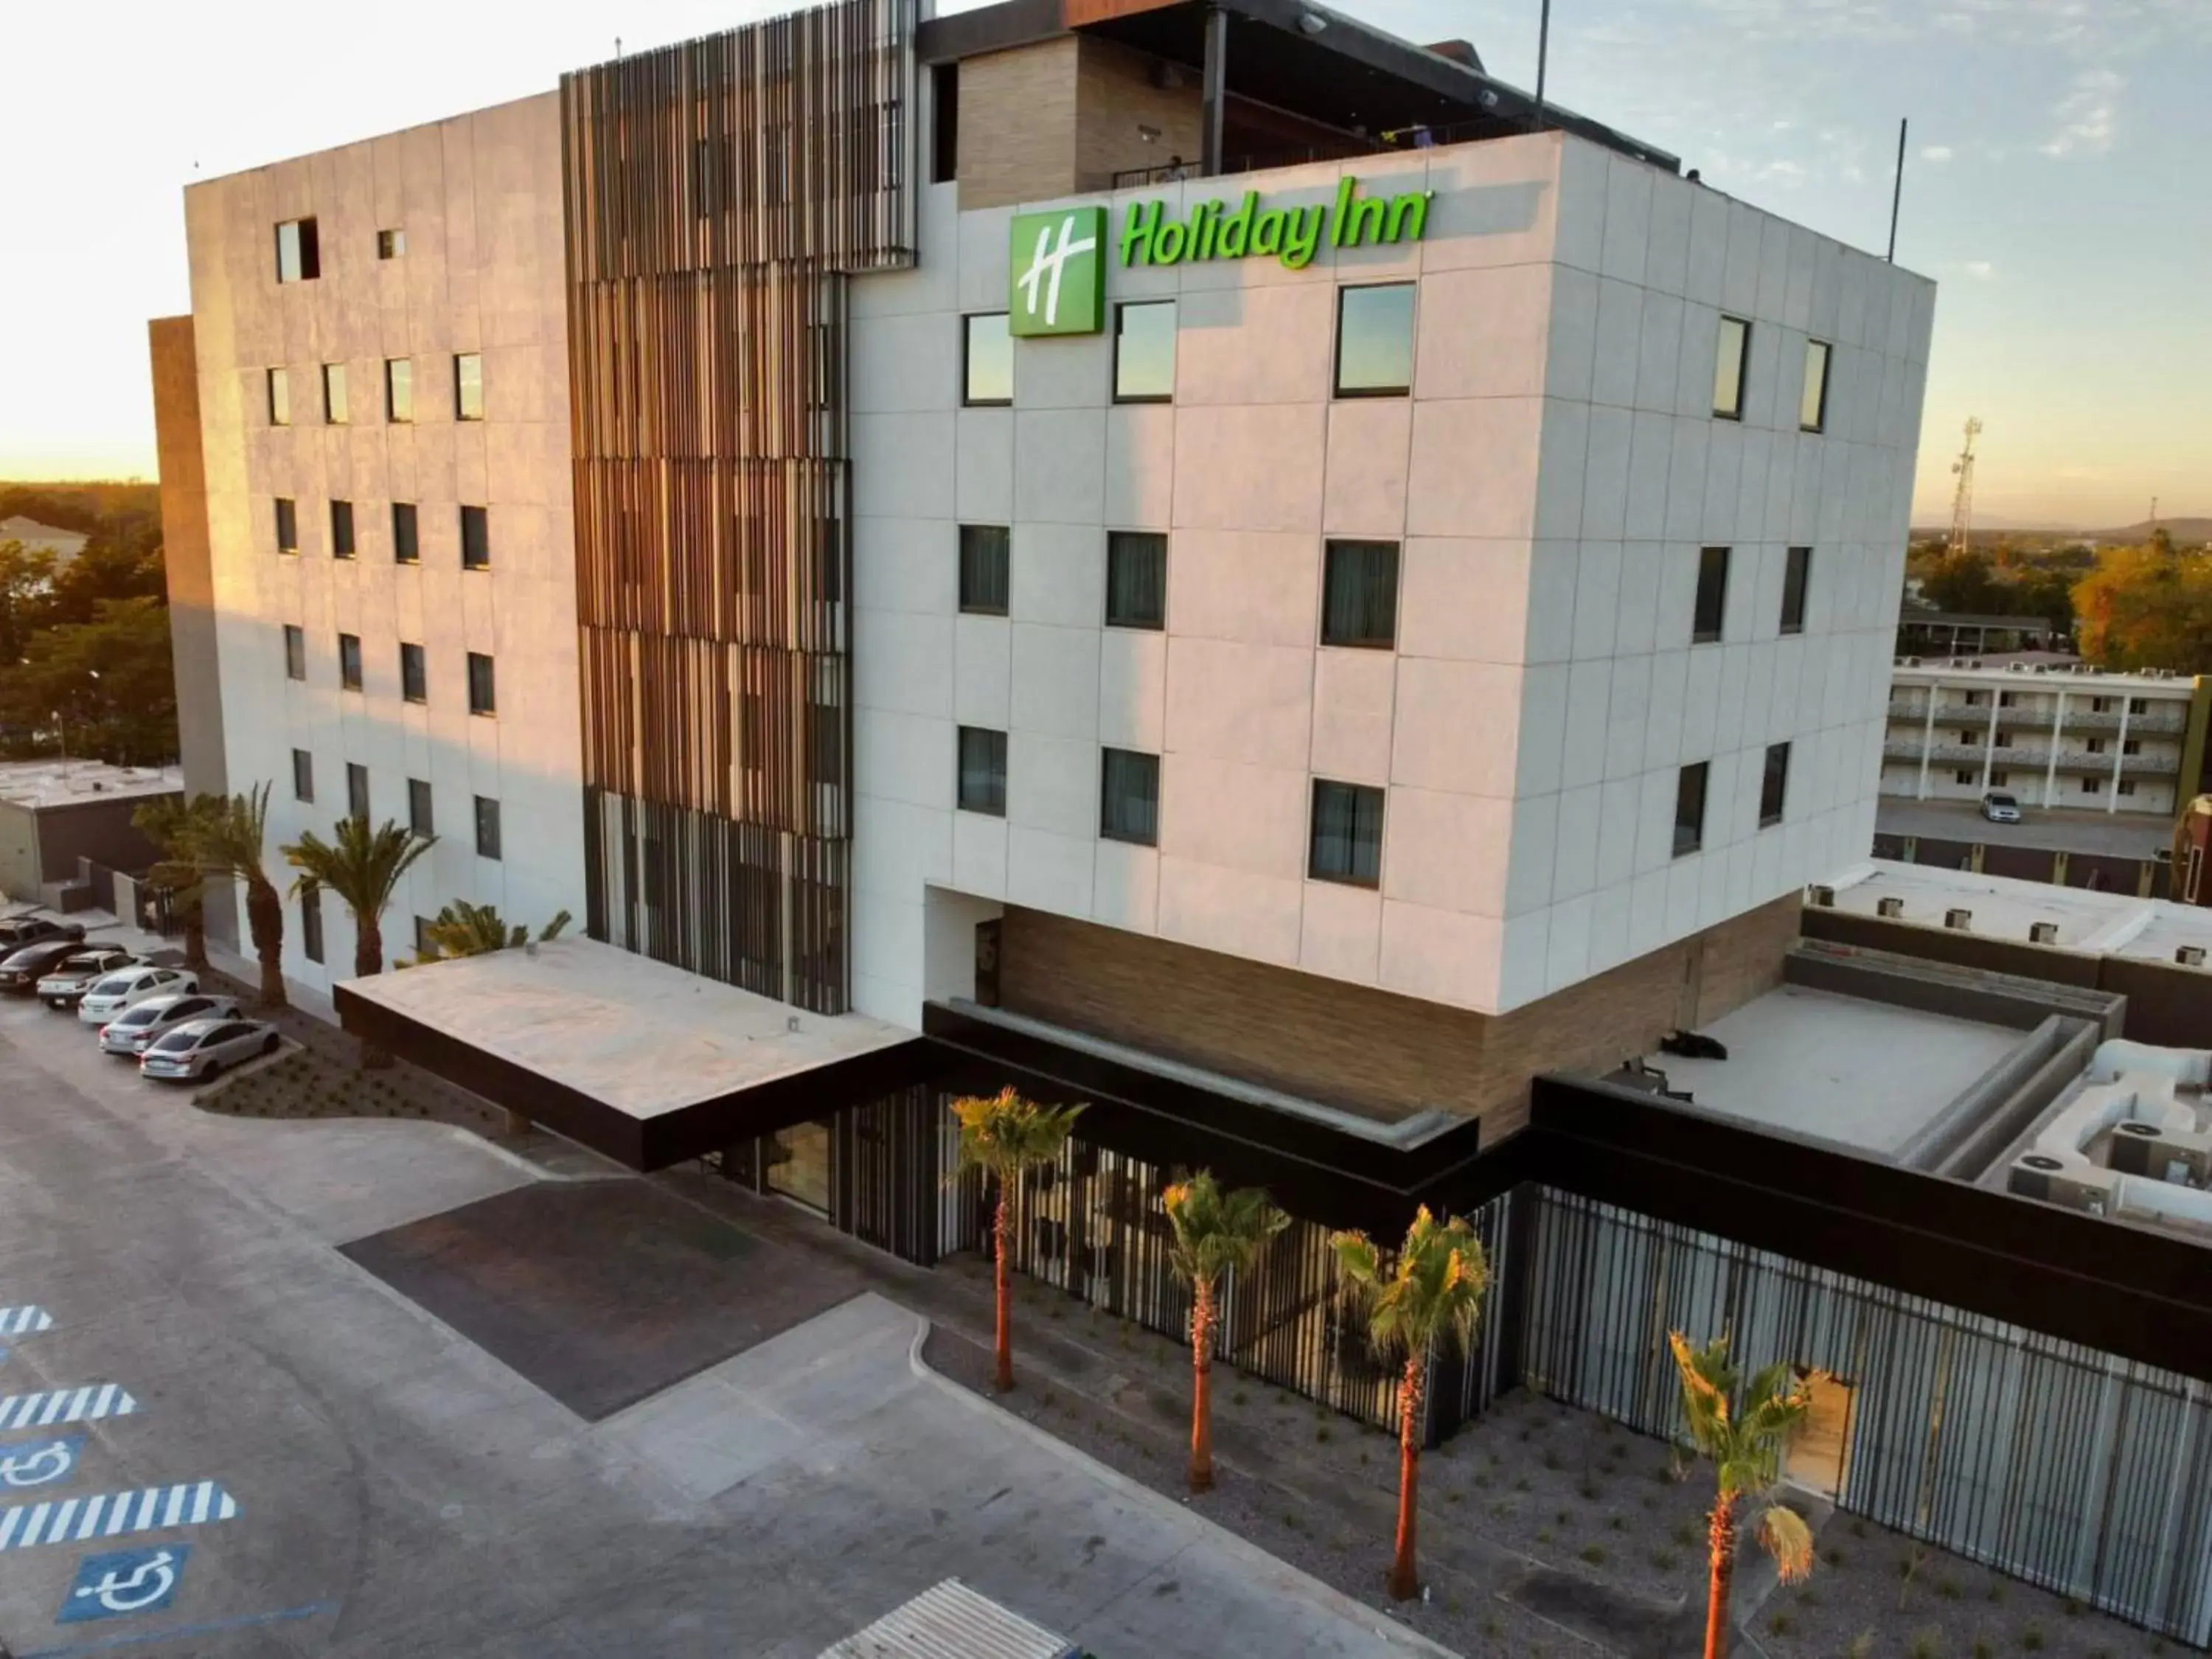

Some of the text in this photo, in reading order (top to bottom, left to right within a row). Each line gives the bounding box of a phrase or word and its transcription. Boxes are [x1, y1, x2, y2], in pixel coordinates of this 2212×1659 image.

[1018, 216, 1096, 325] H
[1119, 176, 1430, 269] Holiday Inn
